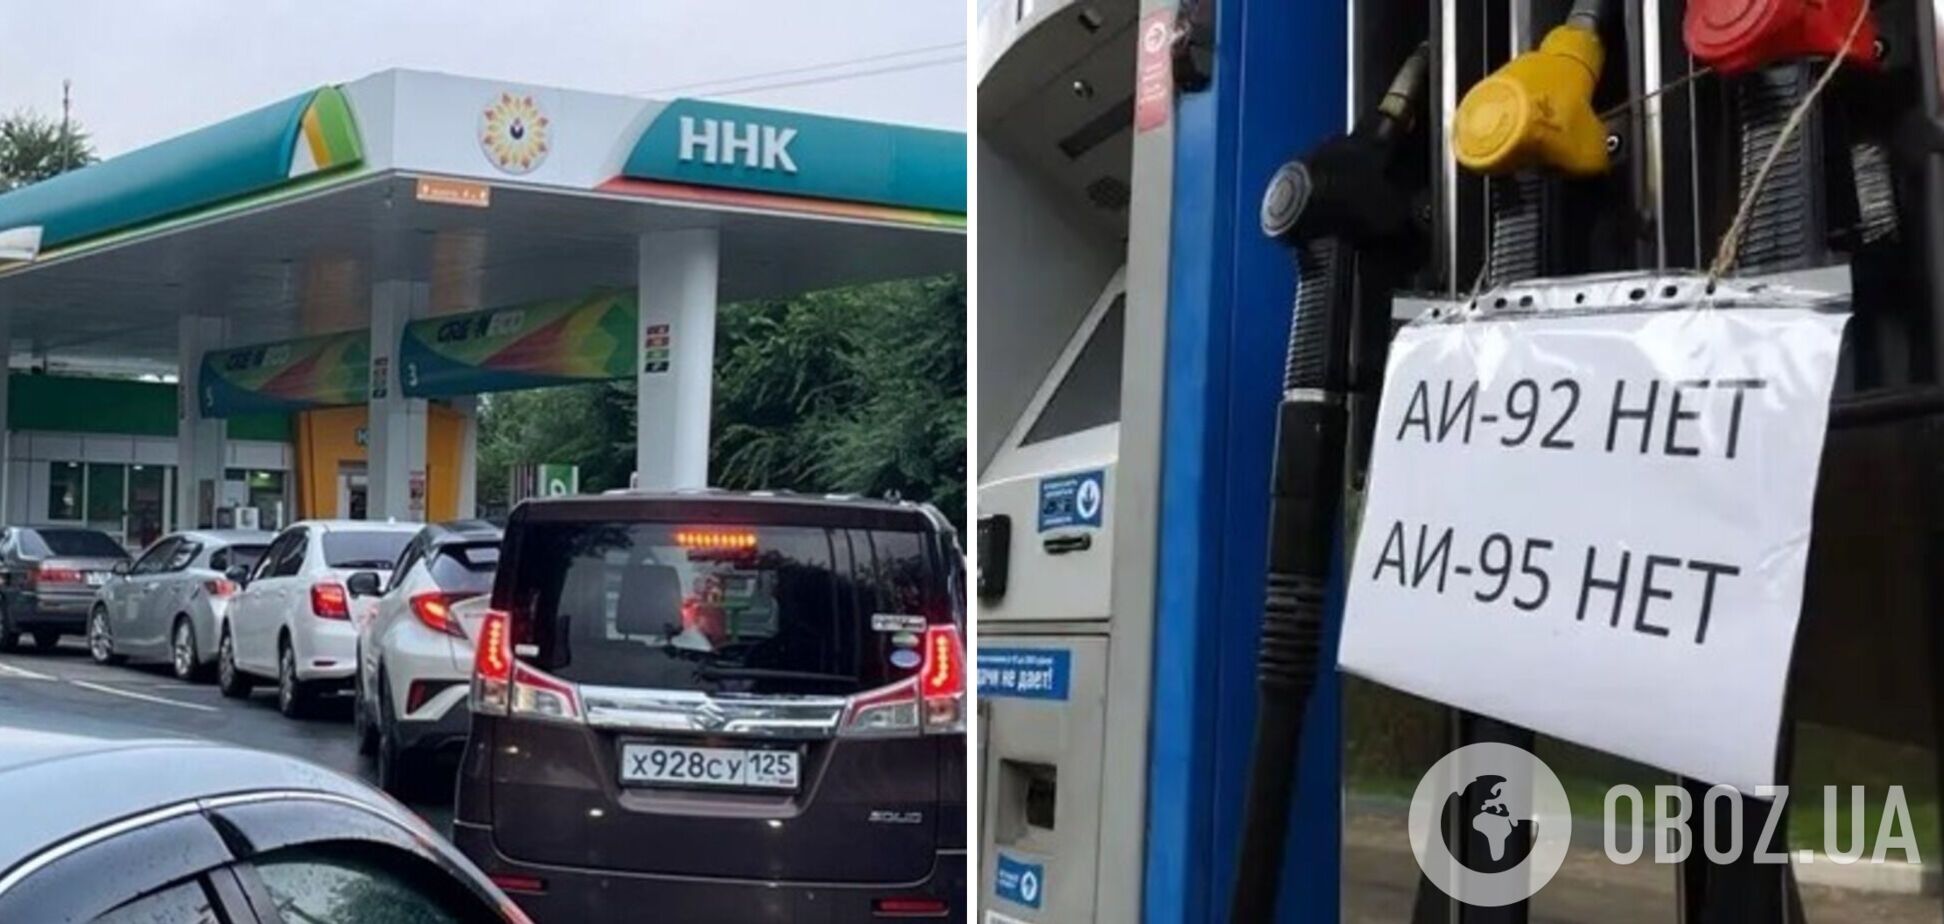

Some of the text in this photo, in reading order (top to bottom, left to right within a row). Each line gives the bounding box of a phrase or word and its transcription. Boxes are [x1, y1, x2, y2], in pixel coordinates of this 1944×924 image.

[679, 116, 798, 173] ННК
[1397, 378, 1767, 459] АИ-92 НЕТ
[1372, 520, 1741, 645] АИ-95 НЕТ
[749, 753, 792, 776] 125
